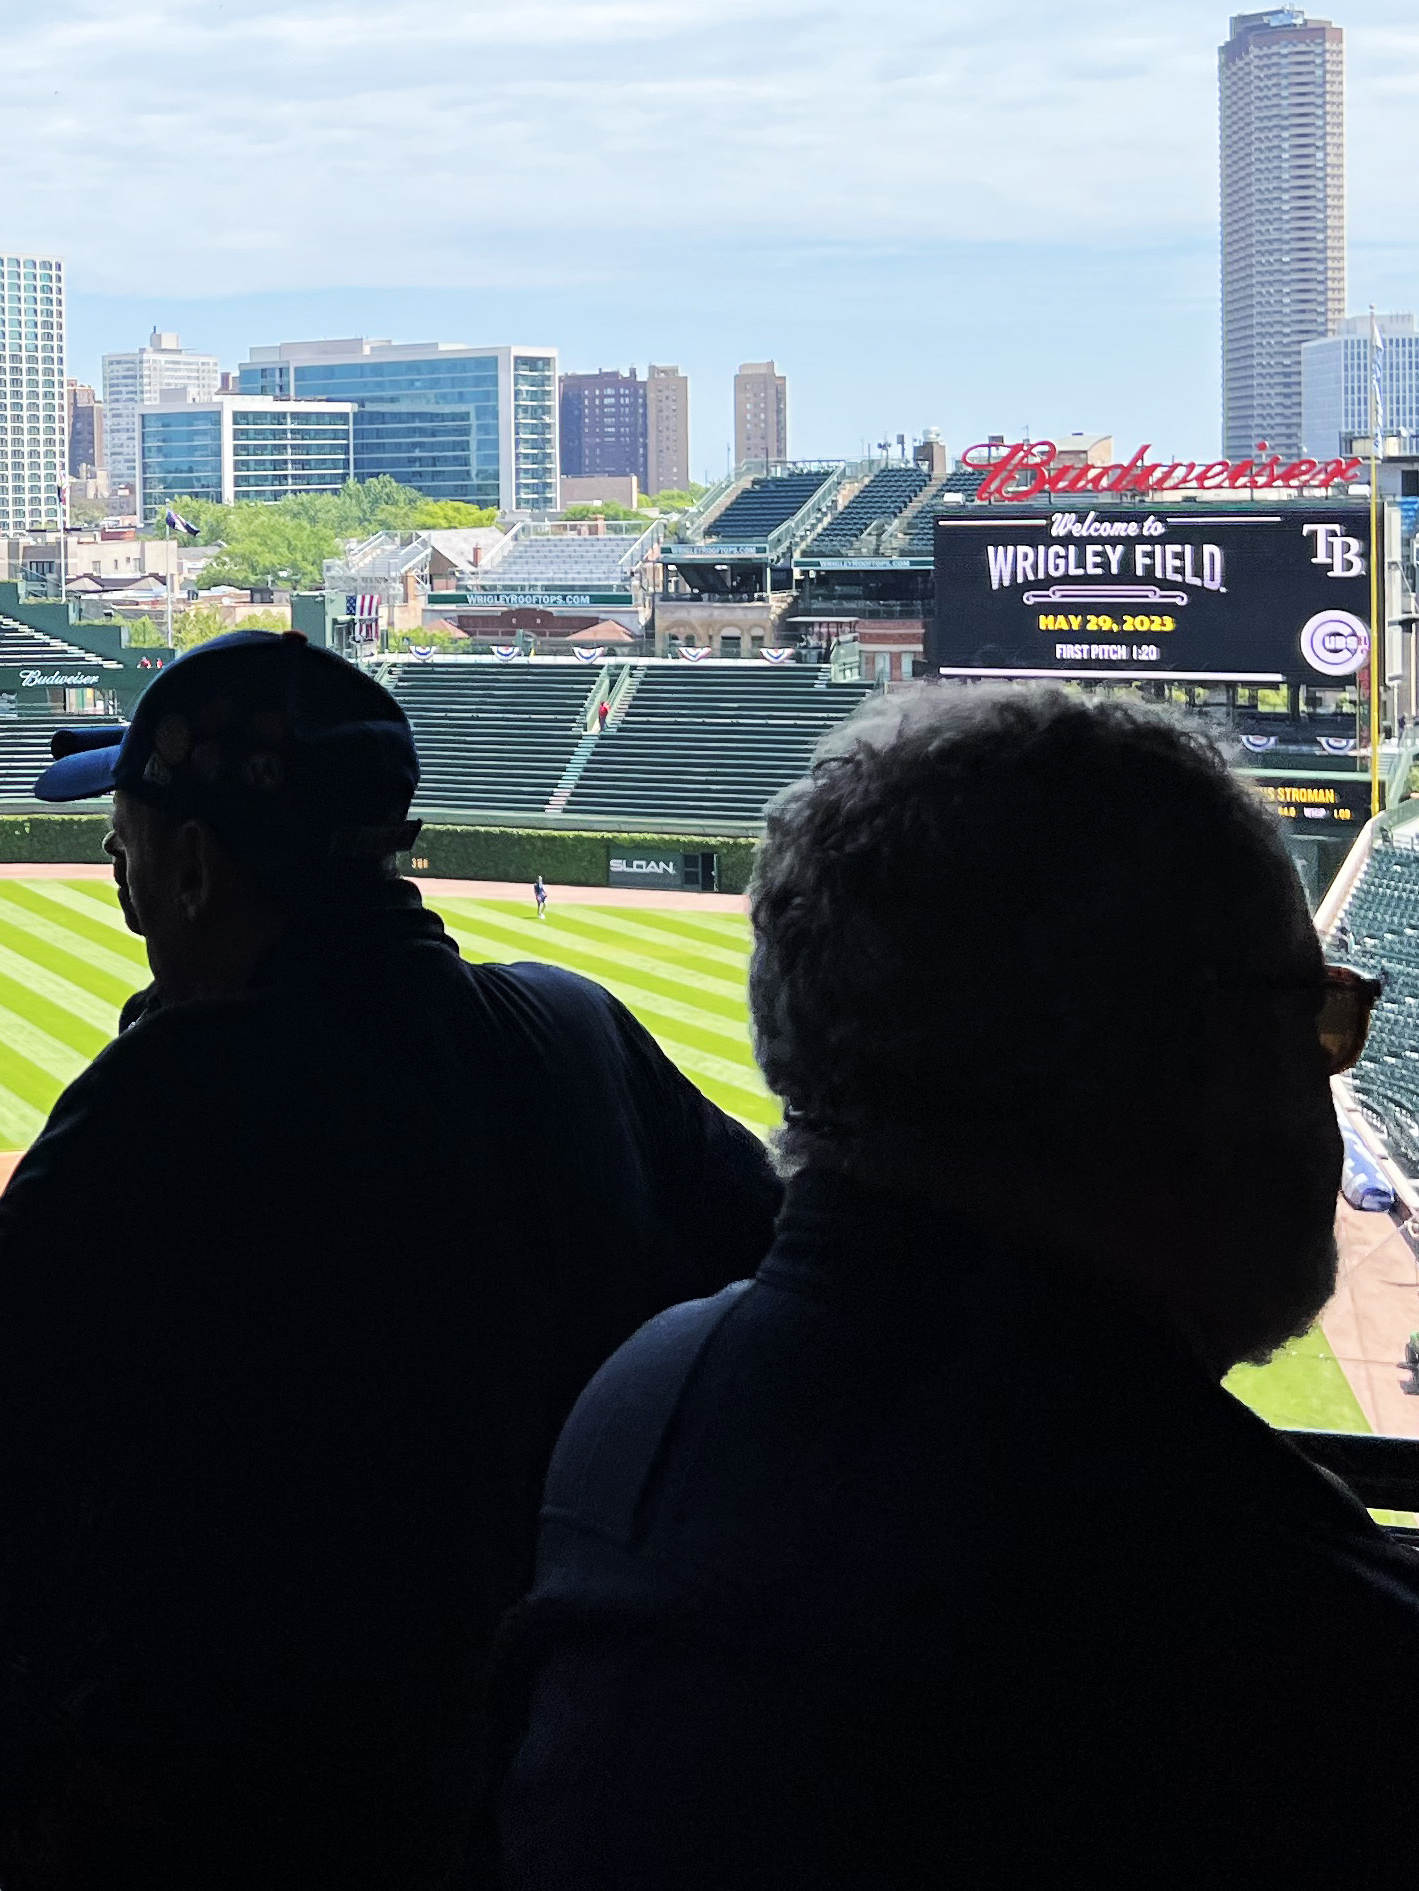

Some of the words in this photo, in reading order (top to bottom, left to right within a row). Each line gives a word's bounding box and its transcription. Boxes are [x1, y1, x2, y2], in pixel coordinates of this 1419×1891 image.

[962, 441, 1364, 501] Budweiser
[1051, 511, 1139, 536] Welcome
[1143, 515, 1166, 536] to
[1302, 524, 1366, 578] TB
[987, 544, 1124, 590] WRIGLEY
[1135, 543, 1224, 591] FIELD
[1038, 614, 1082, 631] MAY
[1086, 615, 1120, 633] 29,
[1123, 615, 1176, 632] 2023
[1055, 643, 1089, 660] FIRST
[1090, 644, 1128, 660] PITCH
[1132, 644, 1160, 661] 1:20
[19, 670, 100, 687] Budweiser
[1277, 786, 1336, 804] STROMAN
[609, 859, 677, 875] SLOAN
